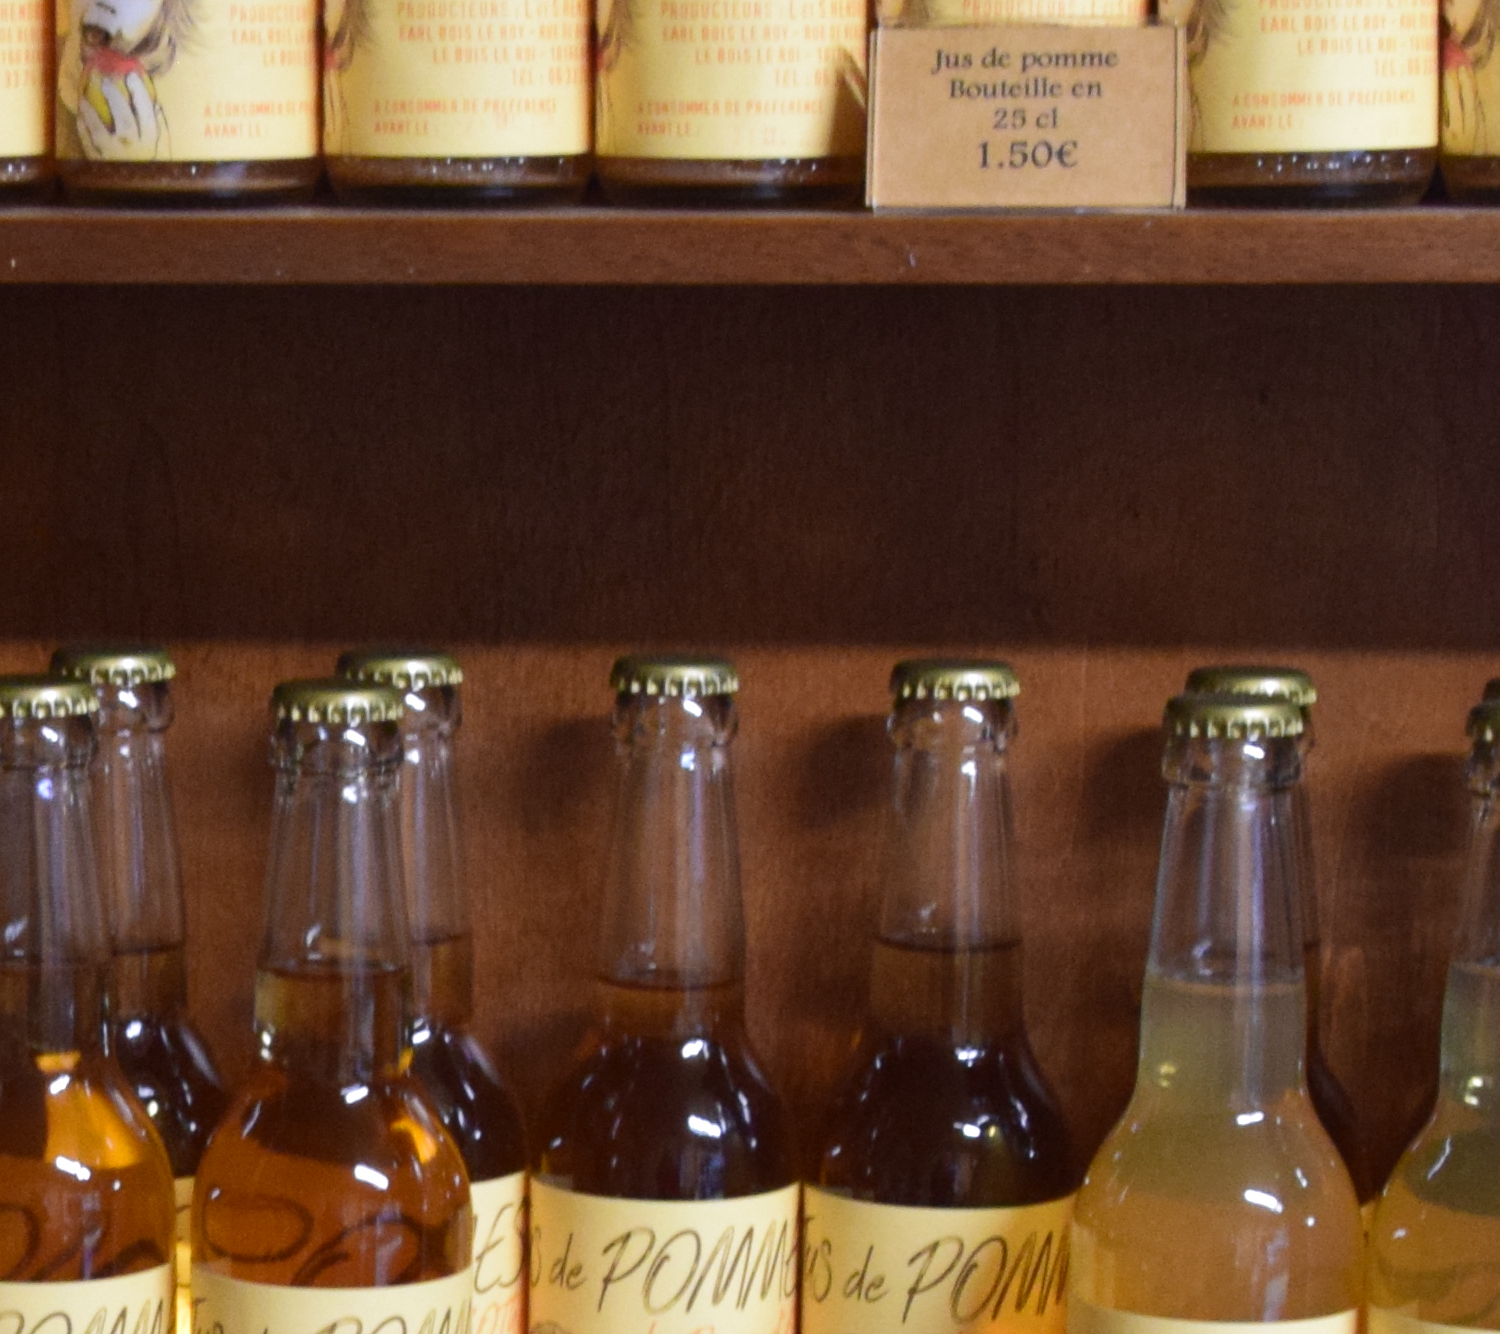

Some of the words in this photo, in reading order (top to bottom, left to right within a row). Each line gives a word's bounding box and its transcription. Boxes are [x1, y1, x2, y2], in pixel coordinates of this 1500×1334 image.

[931, 48, 973, 74] Jus
[981, 47, 1011, 68] de
[1021, 51, 1119, 72] pomme
[950, 77, 1063, 99] Bouteille
[1071, 82, 1103, 98] en
[993, 107, 1026, 129] 25
[1035, 107, 1059, 129] cl
[978, 140, 1079, 170] 1.50€
[549, 1233, 588, 1290] de
[843, 1245, 888, 1303] de
